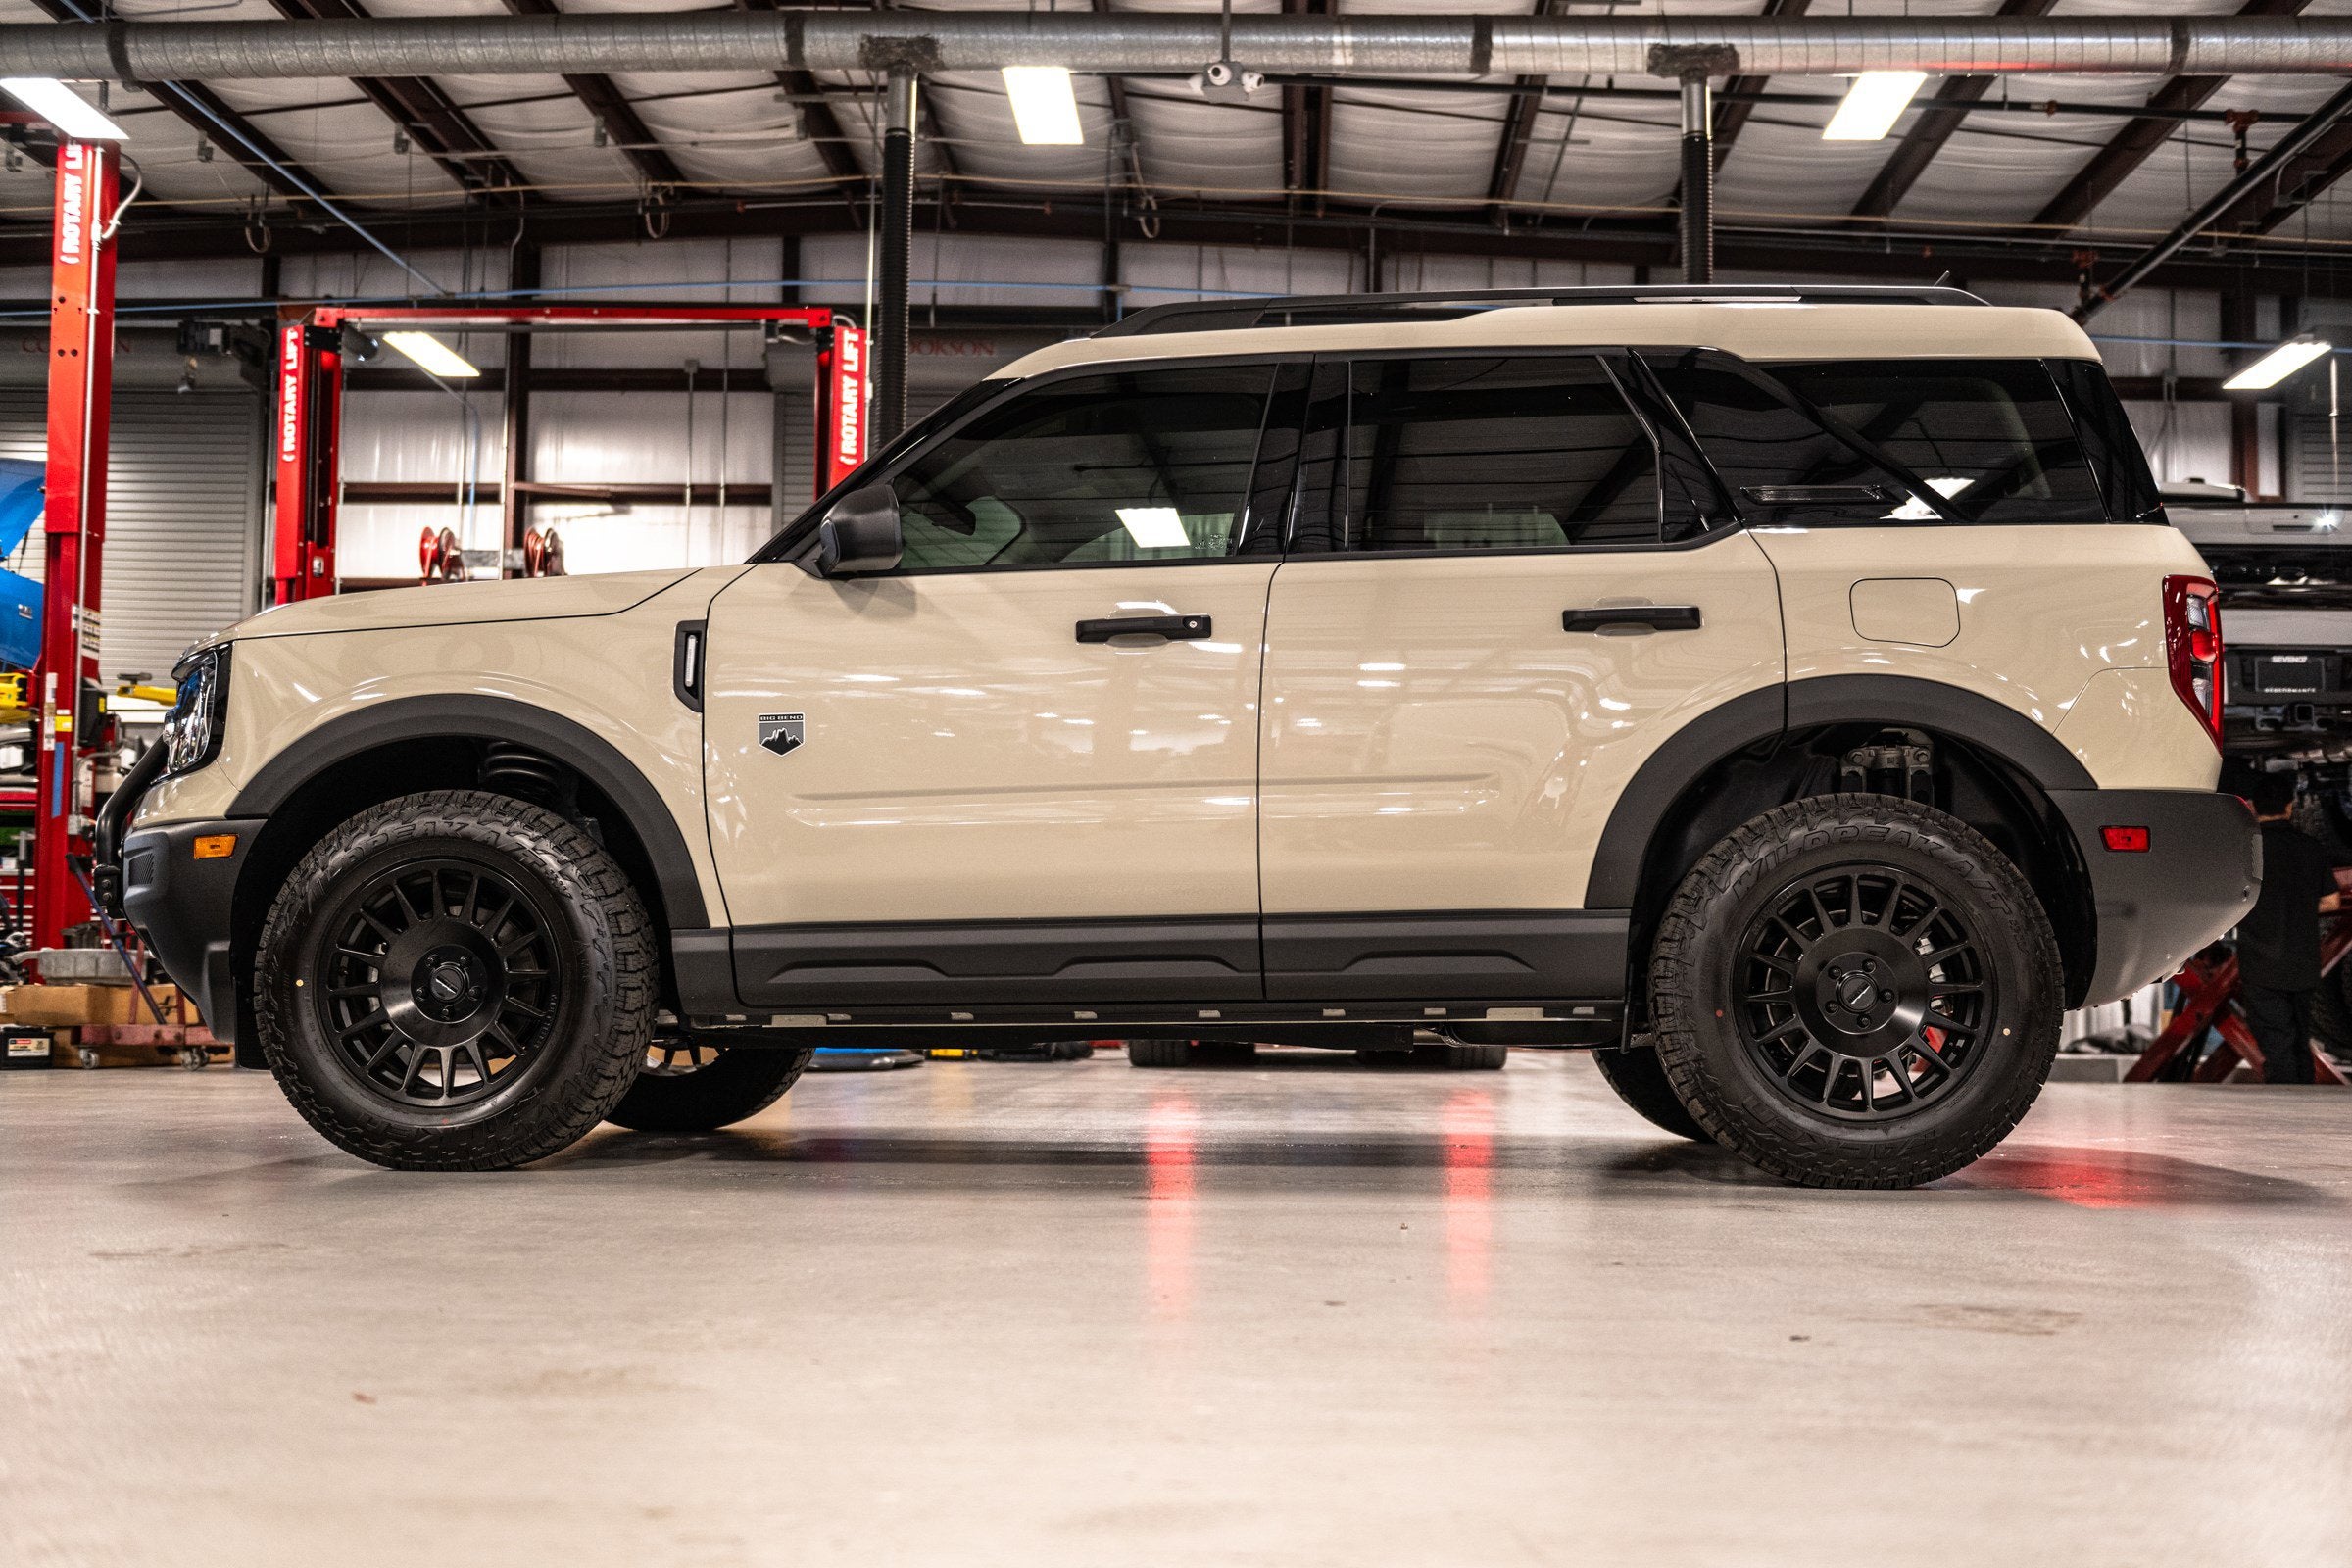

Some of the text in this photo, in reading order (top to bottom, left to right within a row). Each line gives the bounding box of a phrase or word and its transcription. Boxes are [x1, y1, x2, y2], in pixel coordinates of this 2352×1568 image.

[61, 172, 82, 254] ROTARY
[283, 328, 299, 452] ROTARY LIFT
[840, 329, 859, 455] ROTARY LIFT
[1731, 824, 1946, 902] WILDPEAK
